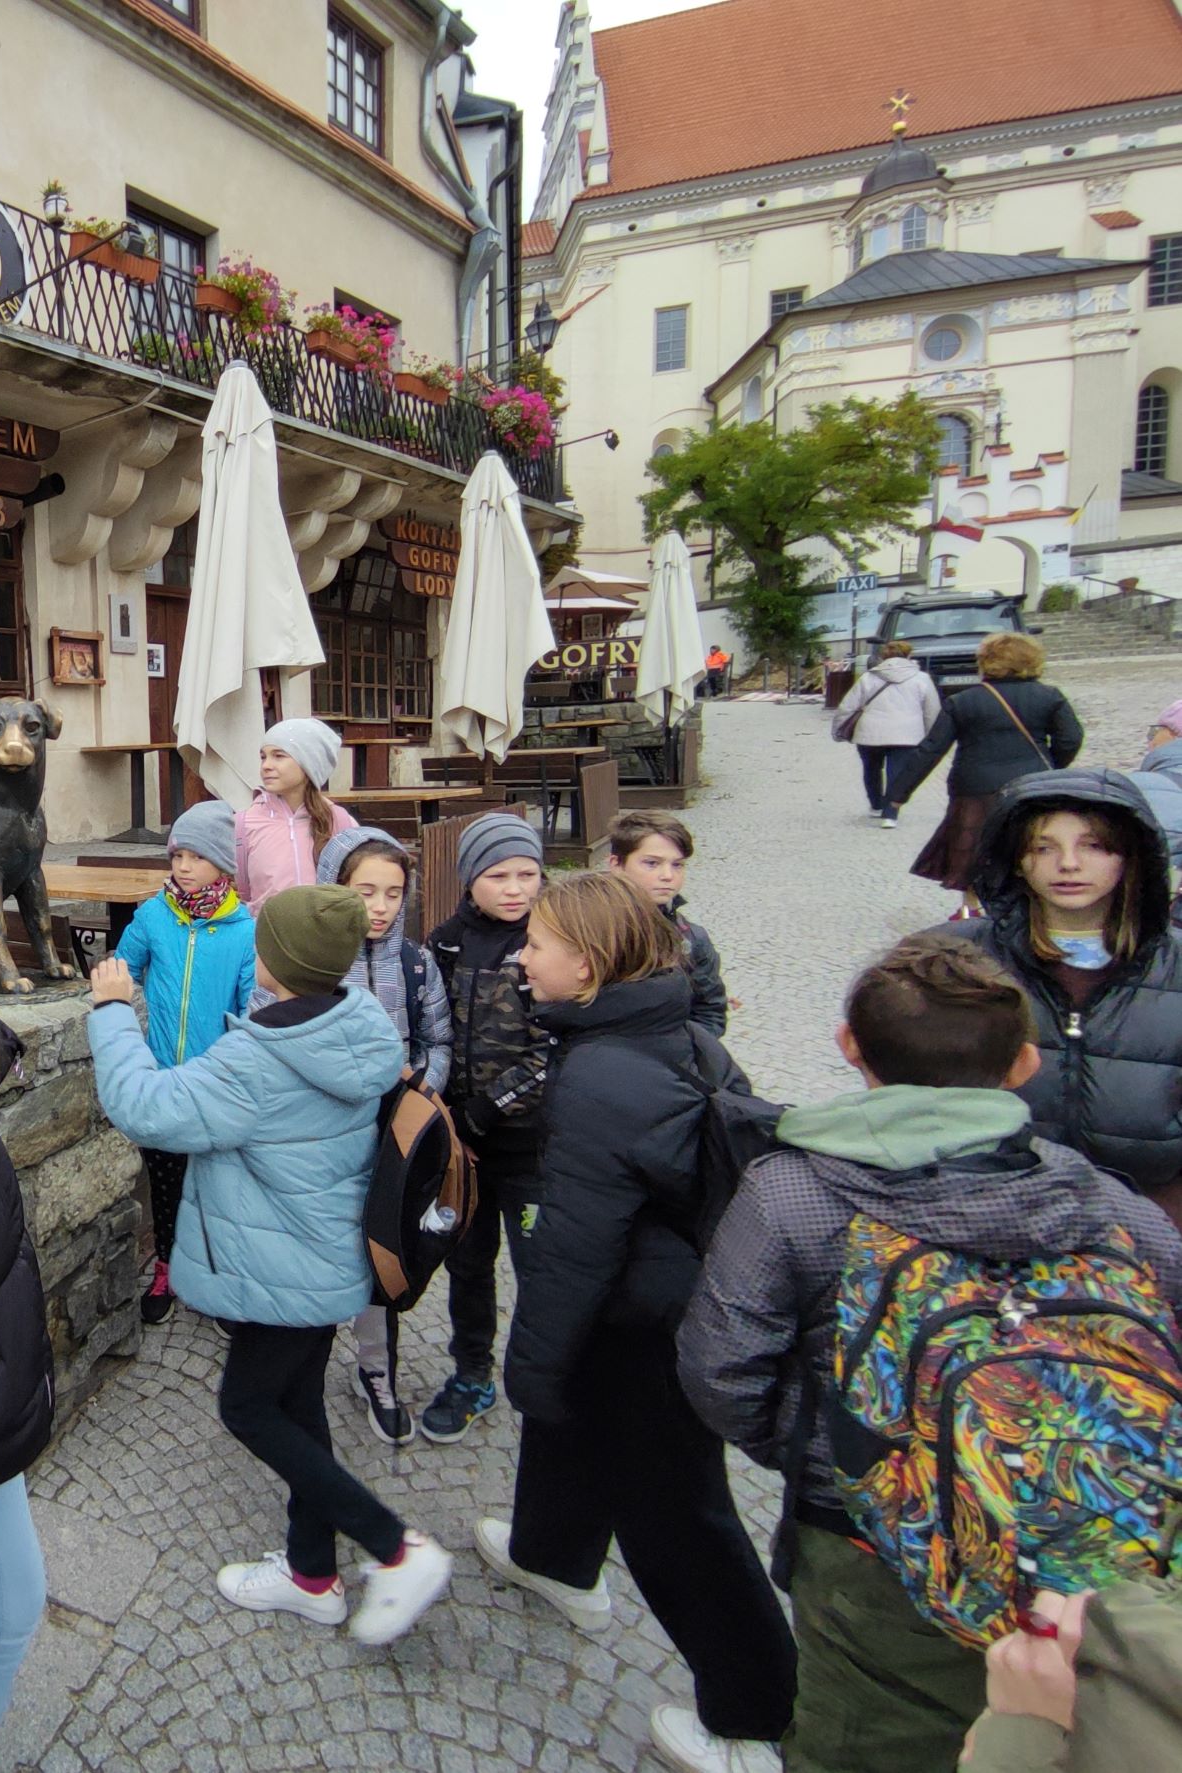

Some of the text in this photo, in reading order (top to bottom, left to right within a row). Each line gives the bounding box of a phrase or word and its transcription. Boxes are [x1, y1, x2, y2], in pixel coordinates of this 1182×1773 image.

[415, 572, 455, 597] LODY
[839, 576, 875, 592] TAXI
[537, 640, 642, 670] GOFRY
